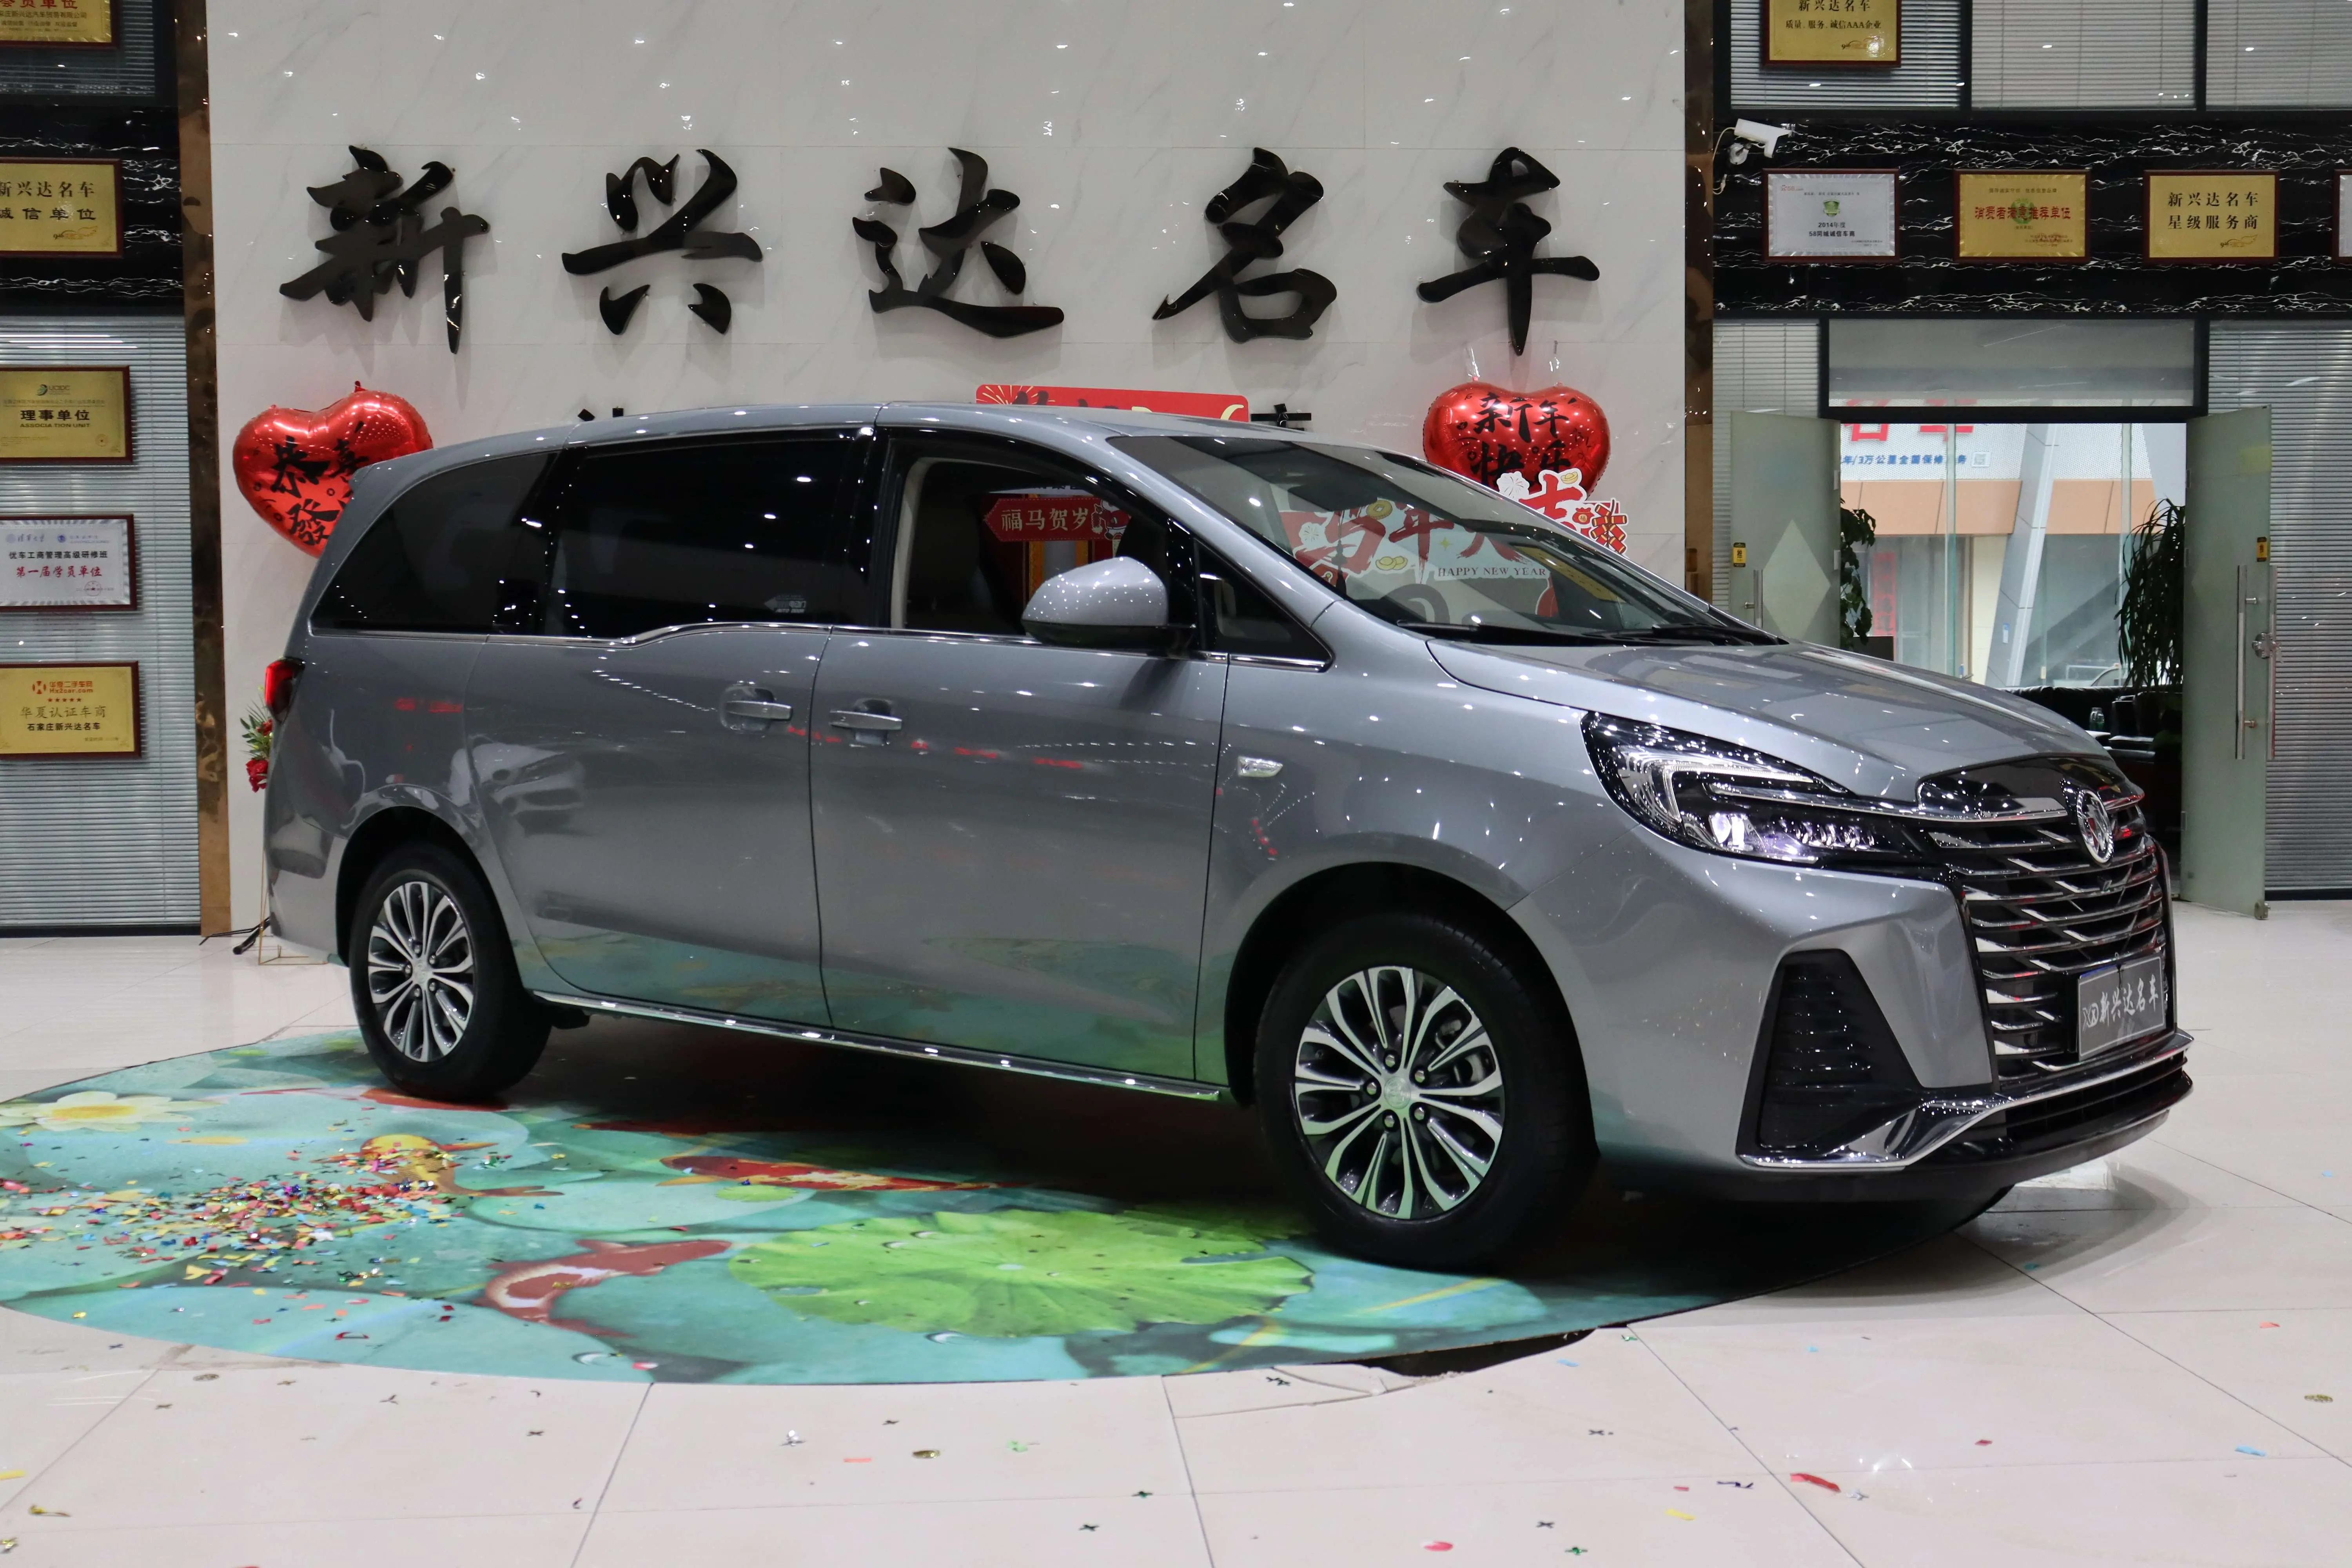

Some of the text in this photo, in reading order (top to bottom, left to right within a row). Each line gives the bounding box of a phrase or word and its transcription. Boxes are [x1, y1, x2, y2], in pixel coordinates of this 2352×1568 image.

[1798, 0, 1870, 11] 新兴达名车
[0, 181, 94, 197] 新兴达名车
[2168, 191, 2259, 207] 新兴达名车
[1975, 206, 2071, 220] 消费者满意推荐单位
[2168, 214, 2259, 229] 星级服务商
[279, 145, 1600, 355] 新兴达名车
[20, 410, 90, 421] 理事单位
[1474, 392, 1570, 442] 新年
[1001, 507, 1089, 531] 福马贺岁
[9, 550, 108, 559] 优车工商管理高级研修班
[16, 566, 103, 578] 第一届学员单位
[1438, 567, 1546, 577] HAPPY NEW YEAR
[20, 706, 107, 719] 华夏认证车商
[27, 722, 100, 731] 石家庄新兴达名车
[2100, 974, 2158, 1027] 新兴达名车
